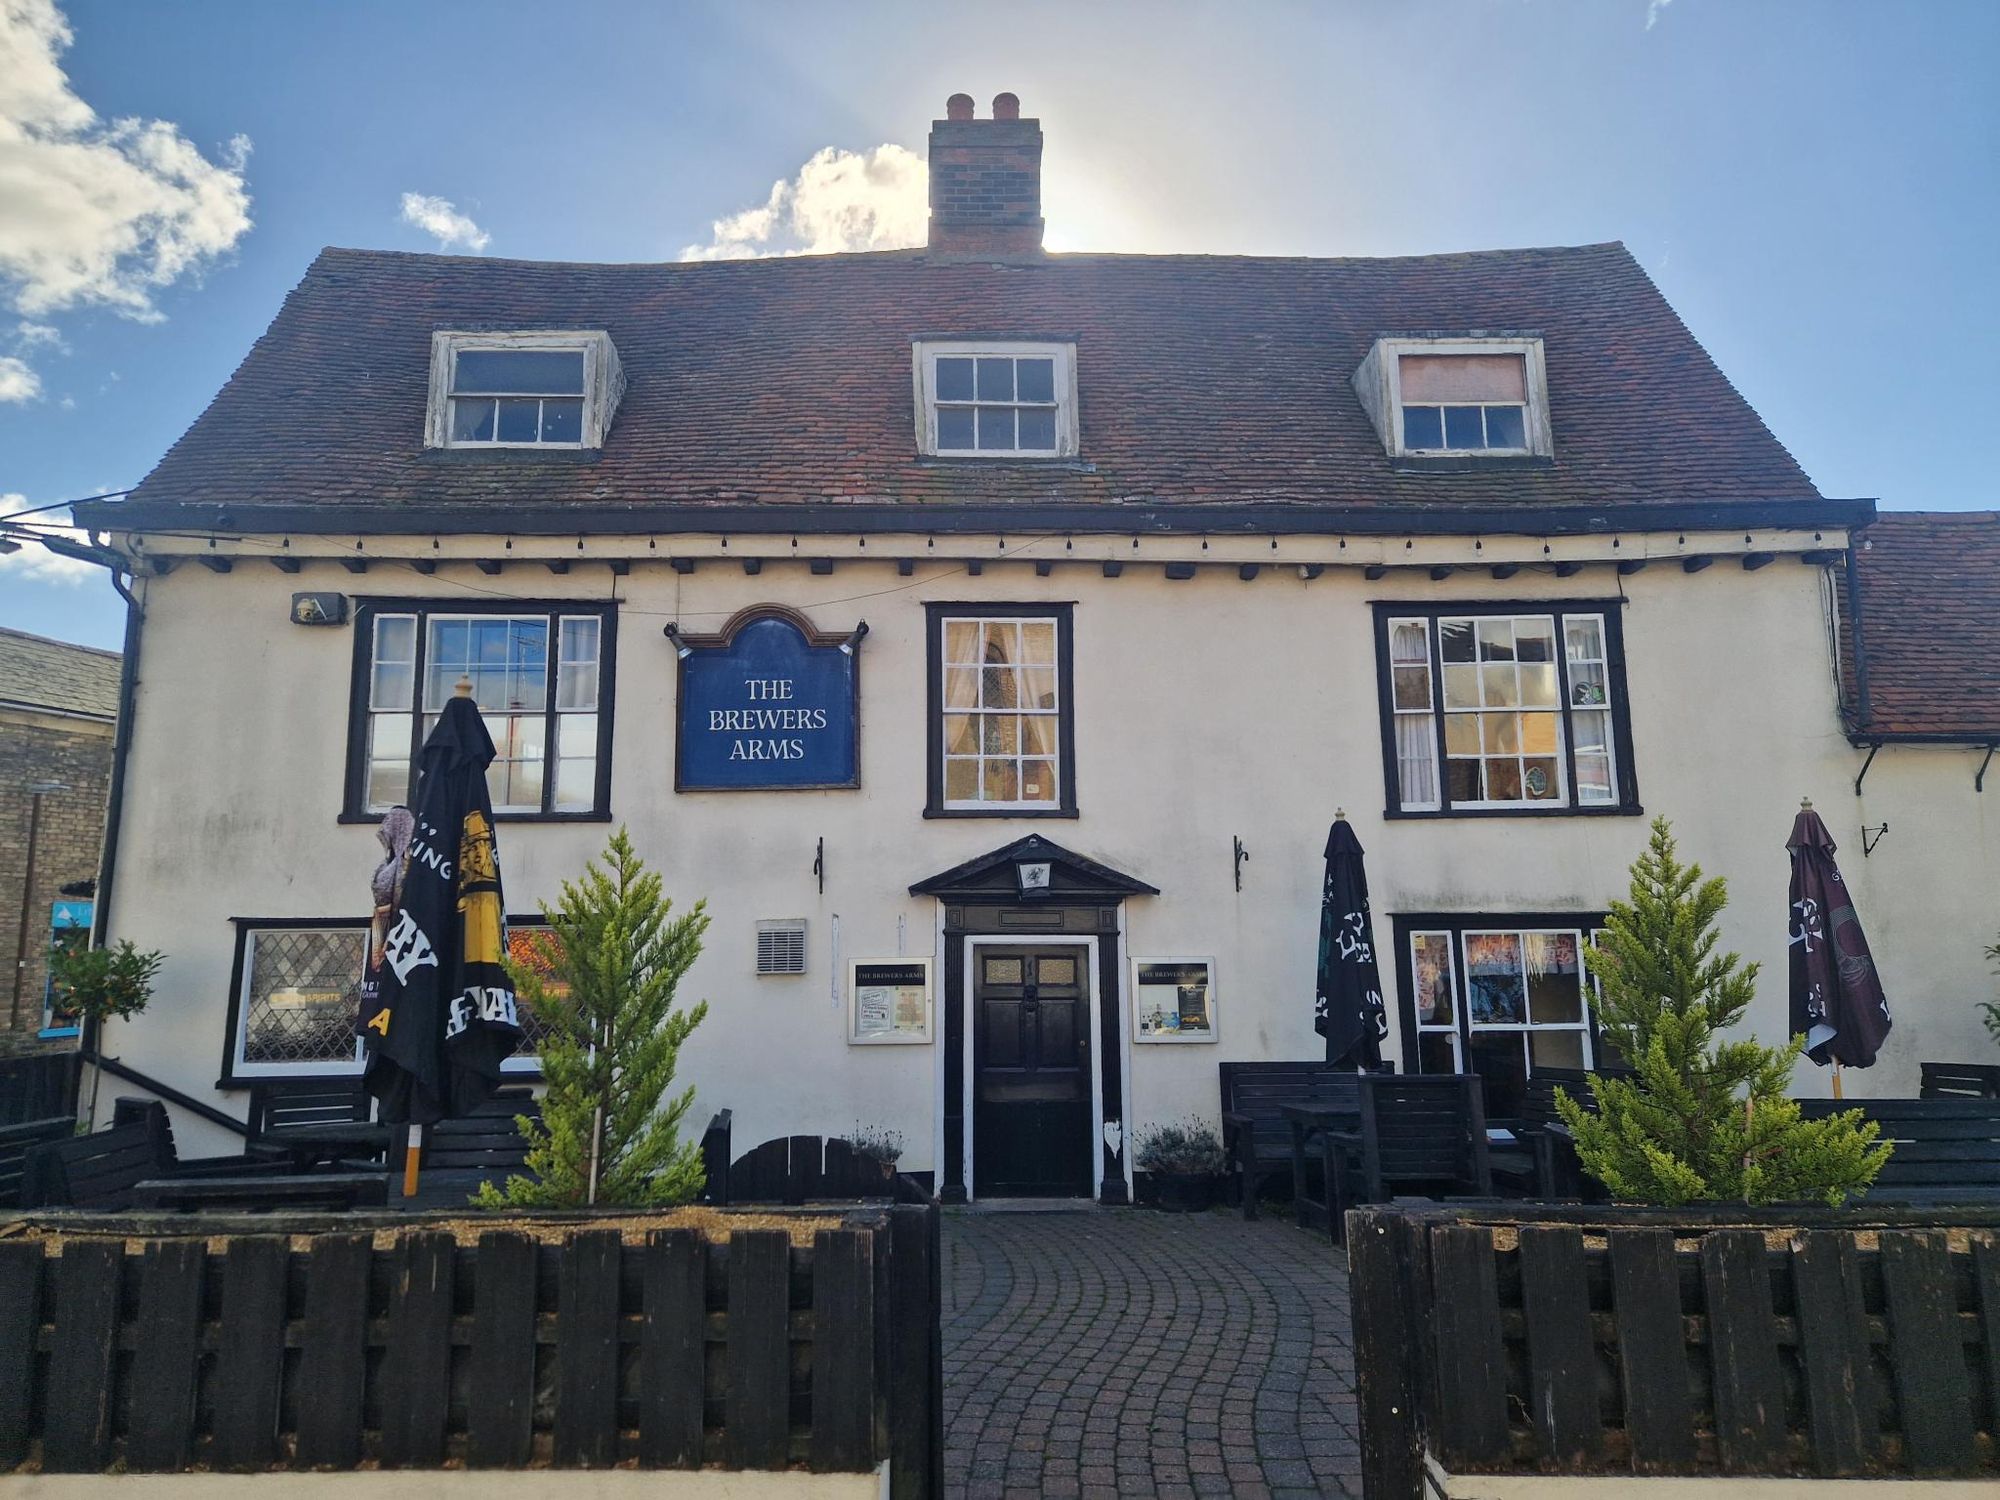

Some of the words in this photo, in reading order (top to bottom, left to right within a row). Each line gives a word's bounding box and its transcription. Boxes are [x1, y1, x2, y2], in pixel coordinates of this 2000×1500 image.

[745, 679, 793, 700] THE
[708, 709, 827, 731] BREWERS
[729, 738, 804, 760] ARMS
